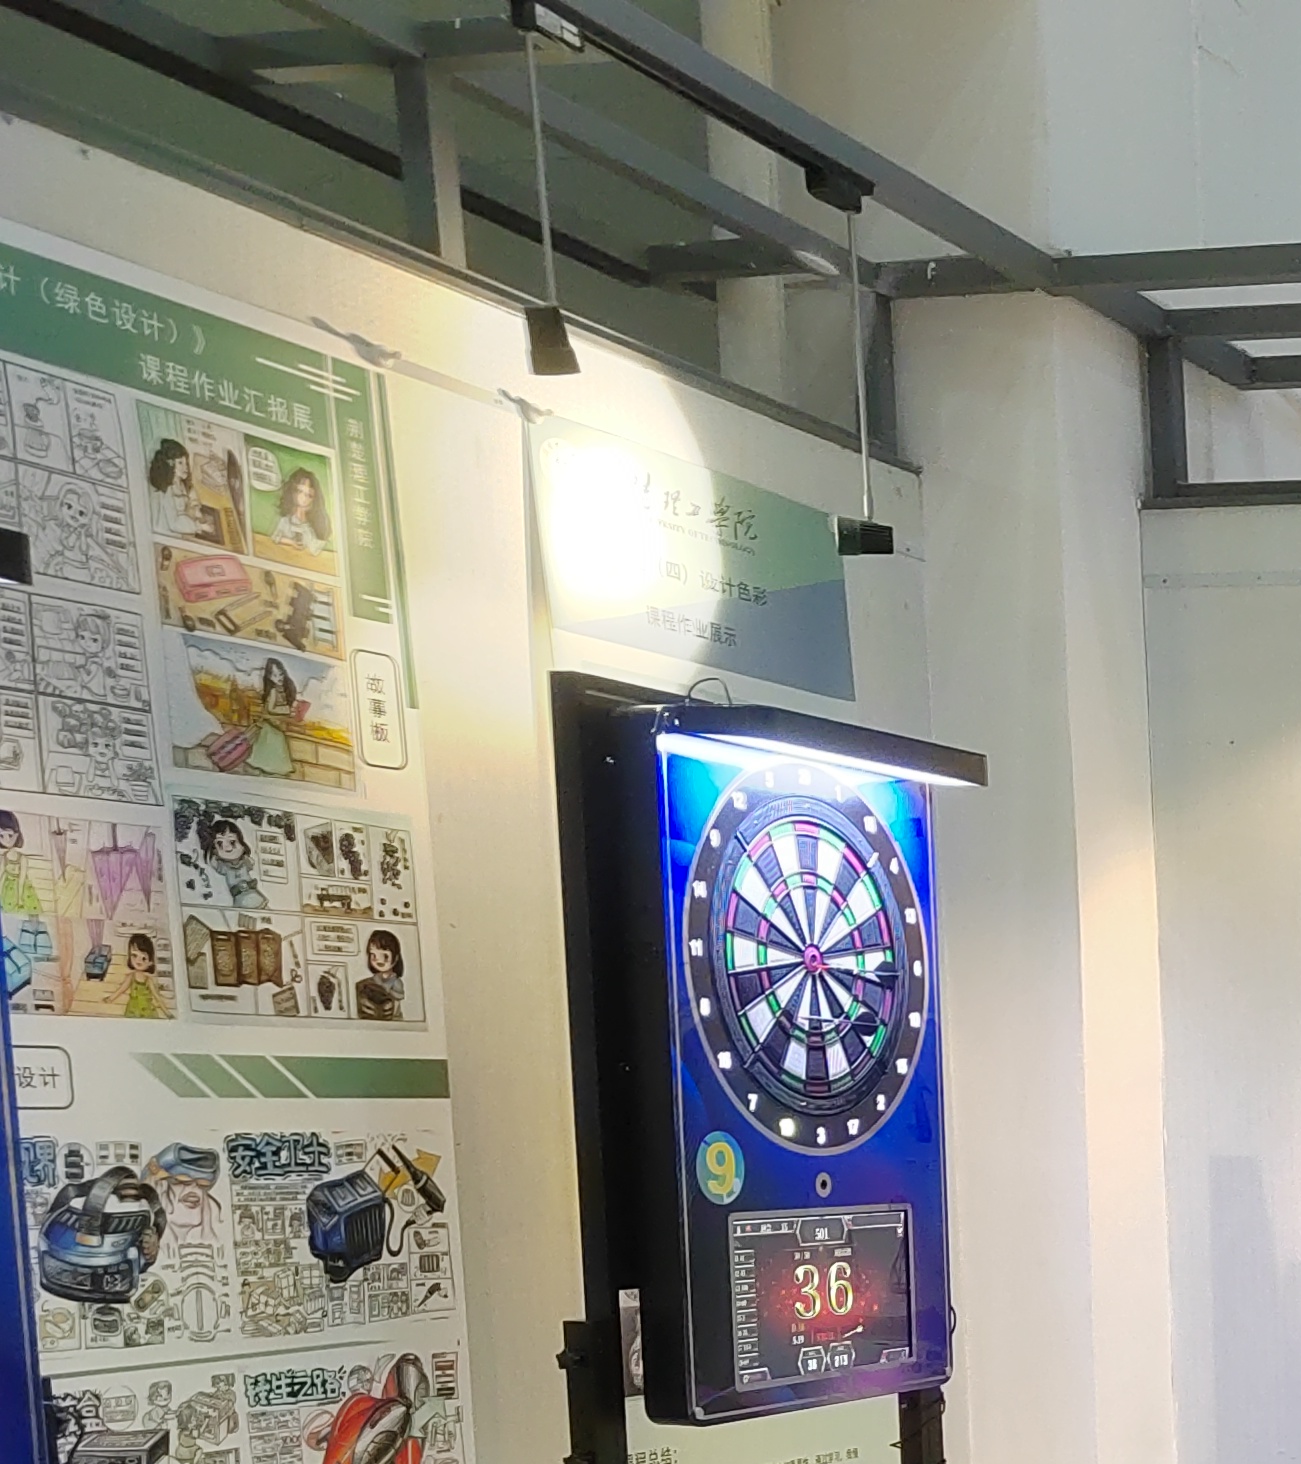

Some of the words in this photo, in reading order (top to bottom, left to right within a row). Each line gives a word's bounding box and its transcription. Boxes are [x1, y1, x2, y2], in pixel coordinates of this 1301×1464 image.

[139, 353, 315, 434] 课程作业汇报展
[646, 604, 737, 648] 课程作业展示
[364, 672, 390, 744] 故事板
[689, 937, 704, 957] 11
[748, 1093, 758, 1113] 7
[876, 1094, 886, 1112] 2
[816, 1125, 826, 1146] 3
[847, 1117, 860, 1137] 17
[226, 1132, 332, 1179] 安全卫士
[705, 1141, 736, 1195] 9
[814, 1227, 830, 1241] 501
[793, 1261, 854, 1319] 36
